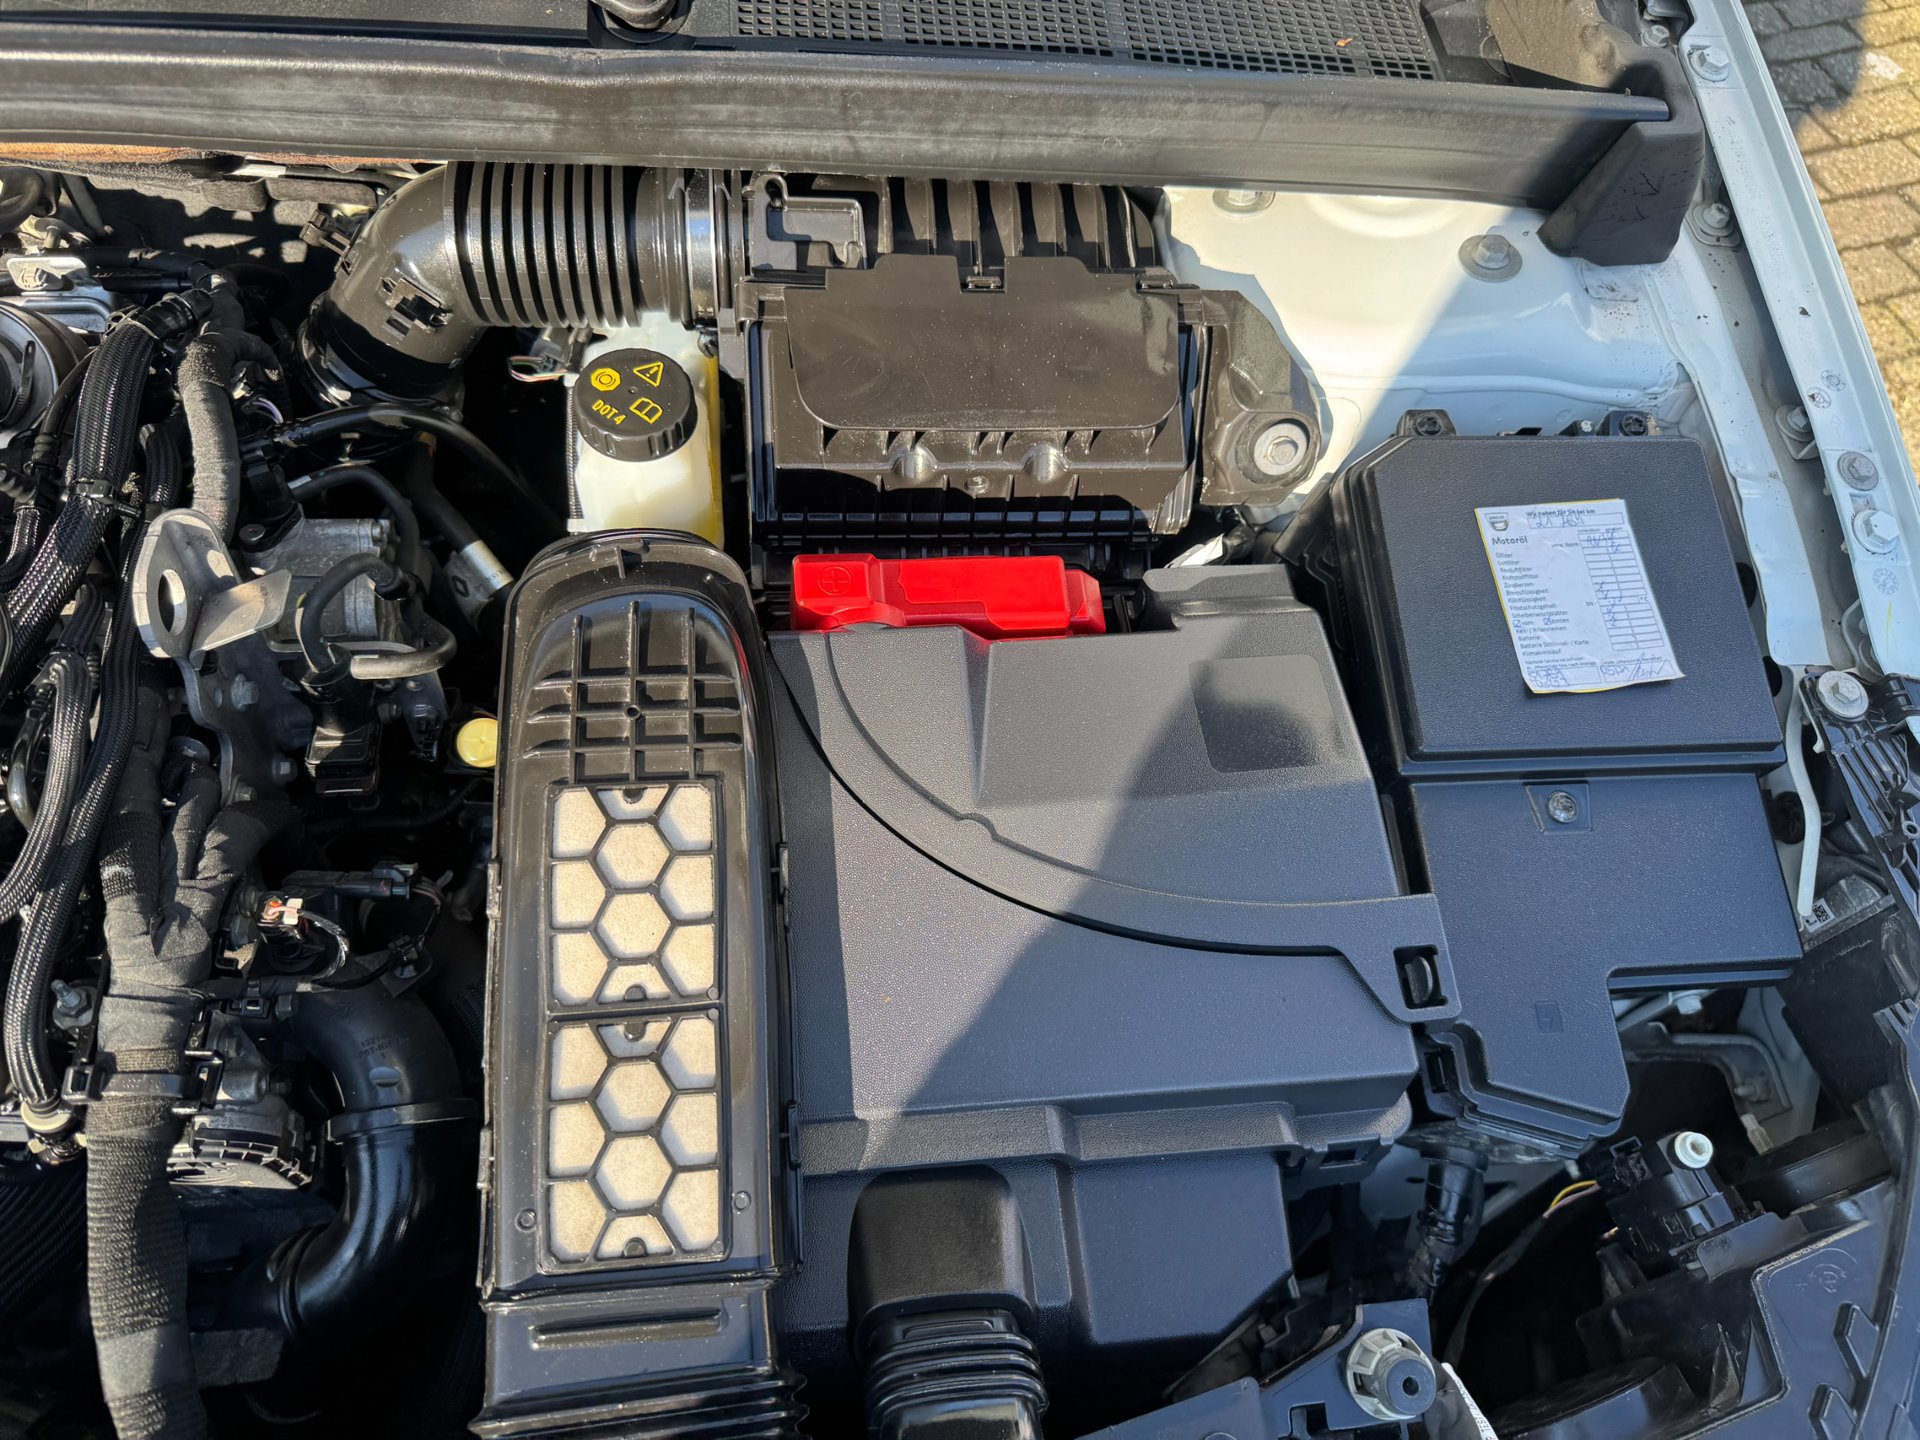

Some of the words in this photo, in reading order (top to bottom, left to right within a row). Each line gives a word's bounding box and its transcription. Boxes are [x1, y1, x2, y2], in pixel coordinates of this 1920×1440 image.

[592, 399, 619, 419] DOT
[614, 414, 626, 425] 4
[1491, 535, 1528, 545] Motoröl
